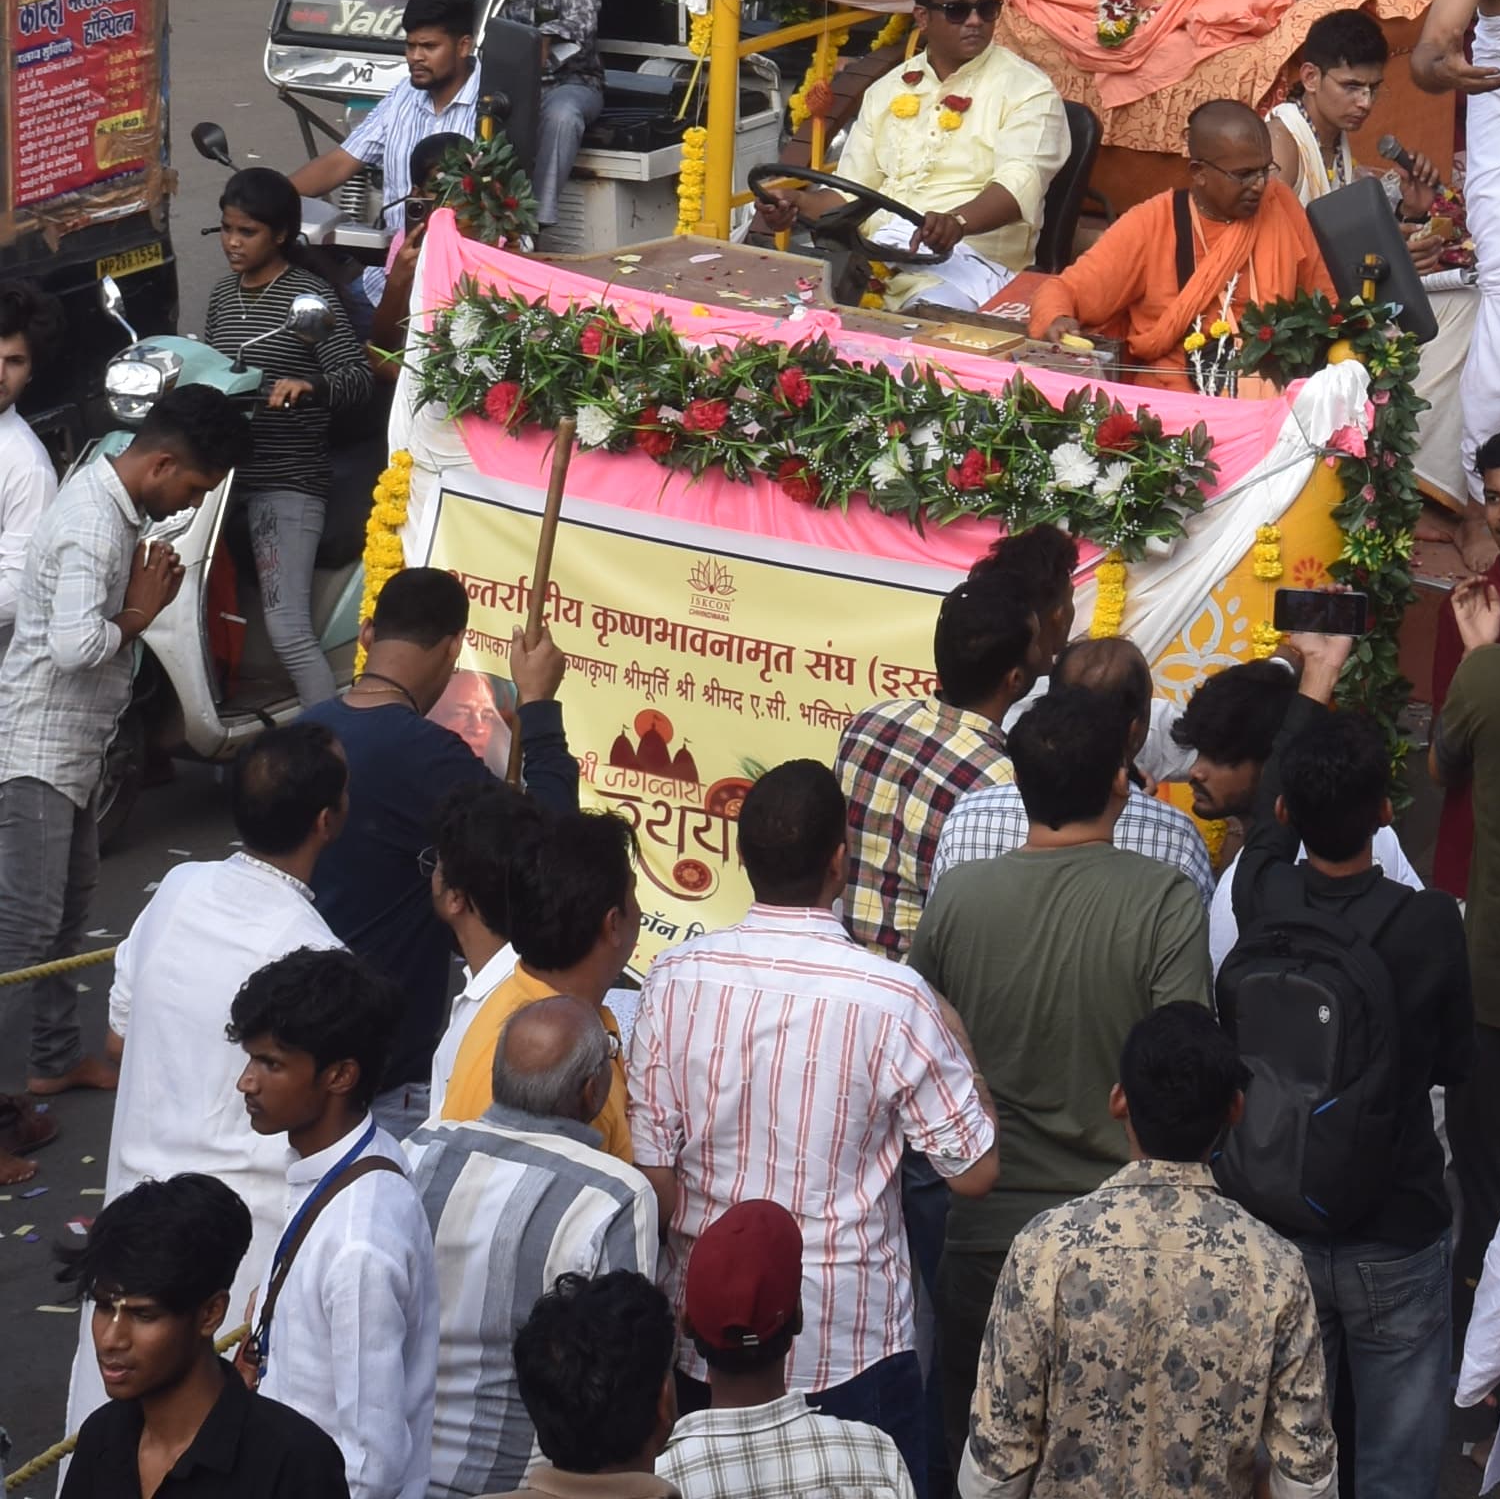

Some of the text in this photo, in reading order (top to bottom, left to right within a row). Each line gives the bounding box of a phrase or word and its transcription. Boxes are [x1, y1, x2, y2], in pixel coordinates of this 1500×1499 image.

[83, 7, 135, 48] हॉस्पिटल
[690, 595, 731, 612] ISKCON
[591, 604, 796, 683] कृष्णभावनामृत
[804, 639, 857, 685] संघ
[623, 660, 669, 702] श्रीमूर्ति
[676, 671, 695, 702] श्री
[701, 677, 744, 714] श्रीमद
[750, 690, 790, 722] ए.सी.
[603, 763, 707, 803] जगन्नाथ
